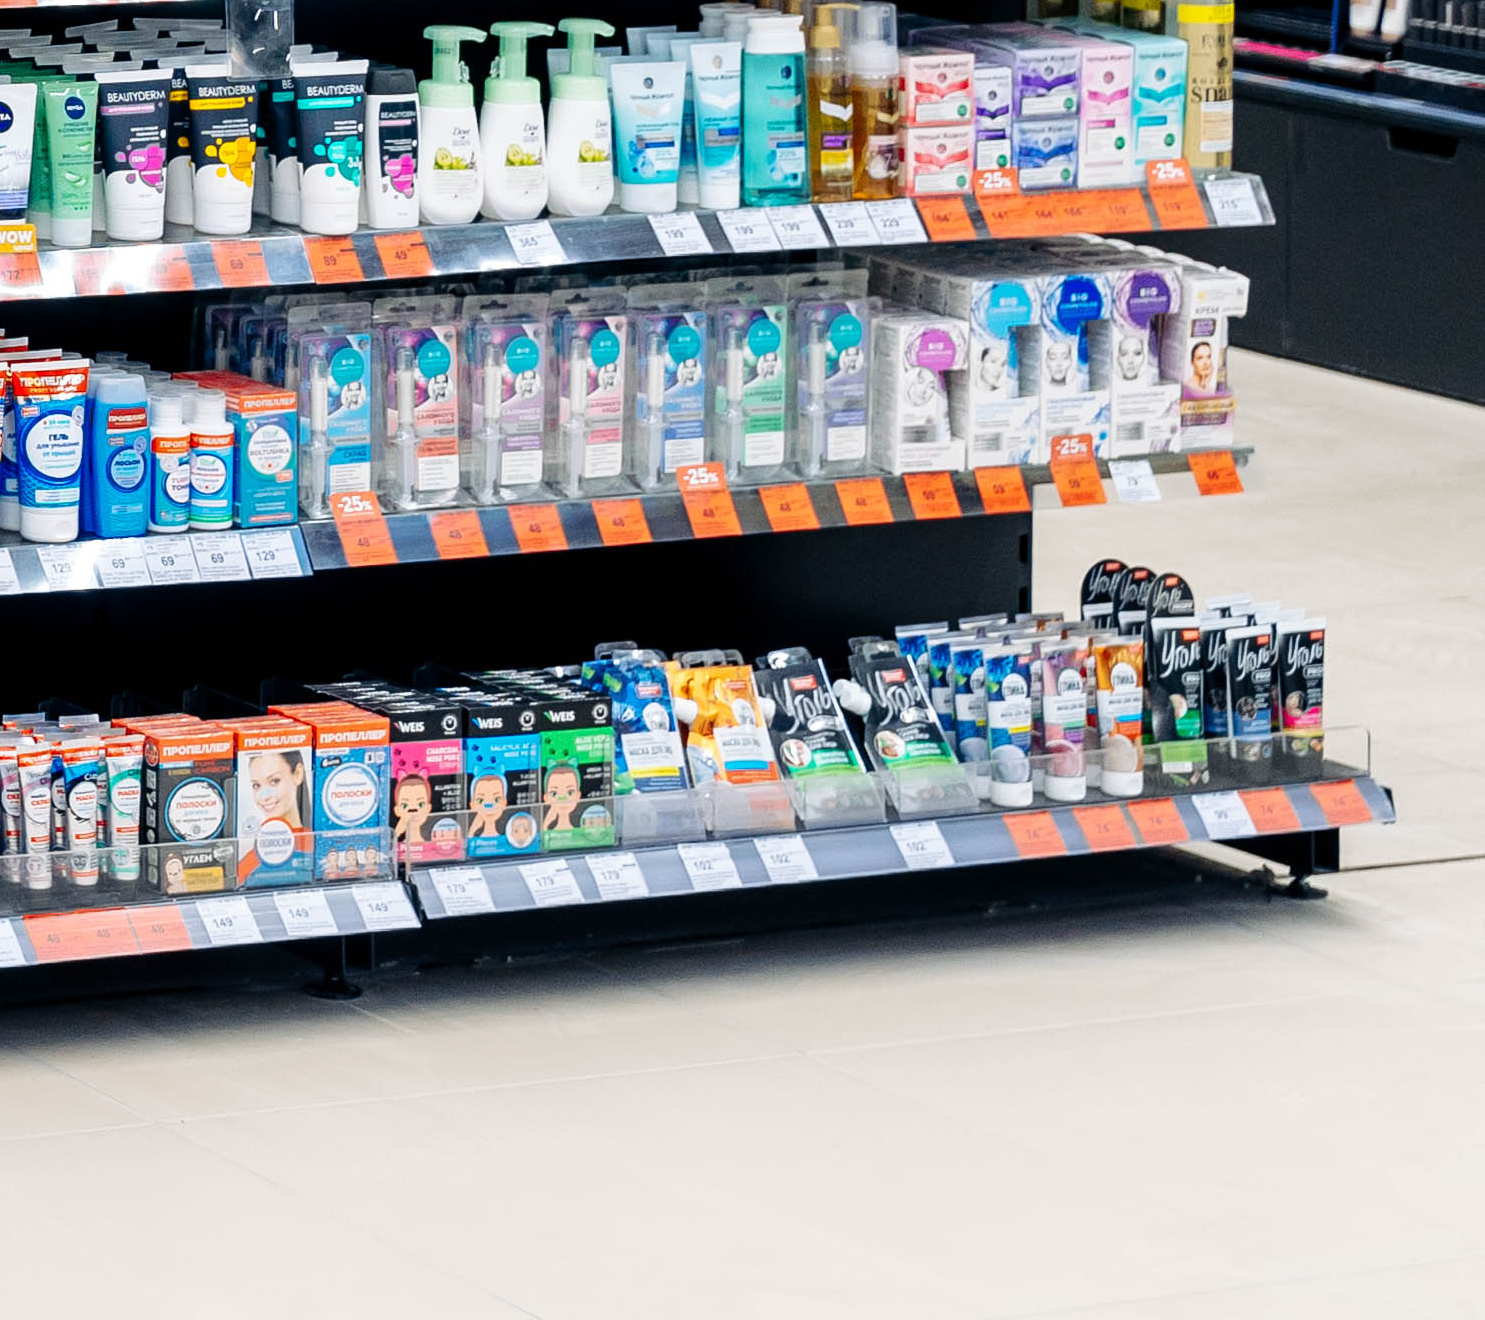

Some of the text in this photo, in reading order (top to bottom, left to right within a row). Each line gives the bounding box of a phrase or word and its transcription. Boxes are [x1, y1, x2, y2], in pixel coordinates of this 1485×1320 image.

[107, 90, 166, 101] BEAUTYDERM
[199, 86, 256, 98] BEAUTYDERM
[307, 84, 364, 97] BEAUTYDERM
[337, 495, 371, 513] -25%
[399, 720, 424, 733] WEIS
[478, 717, 503, 730] WEIS
[243, 733, 307, 749] ПРОПЕЛЛЕР
[319, 729, 387, 744] ПРОПЕЛЛЕР
[162, 742, 232, 758] ПРОПЕЛЛЕР
